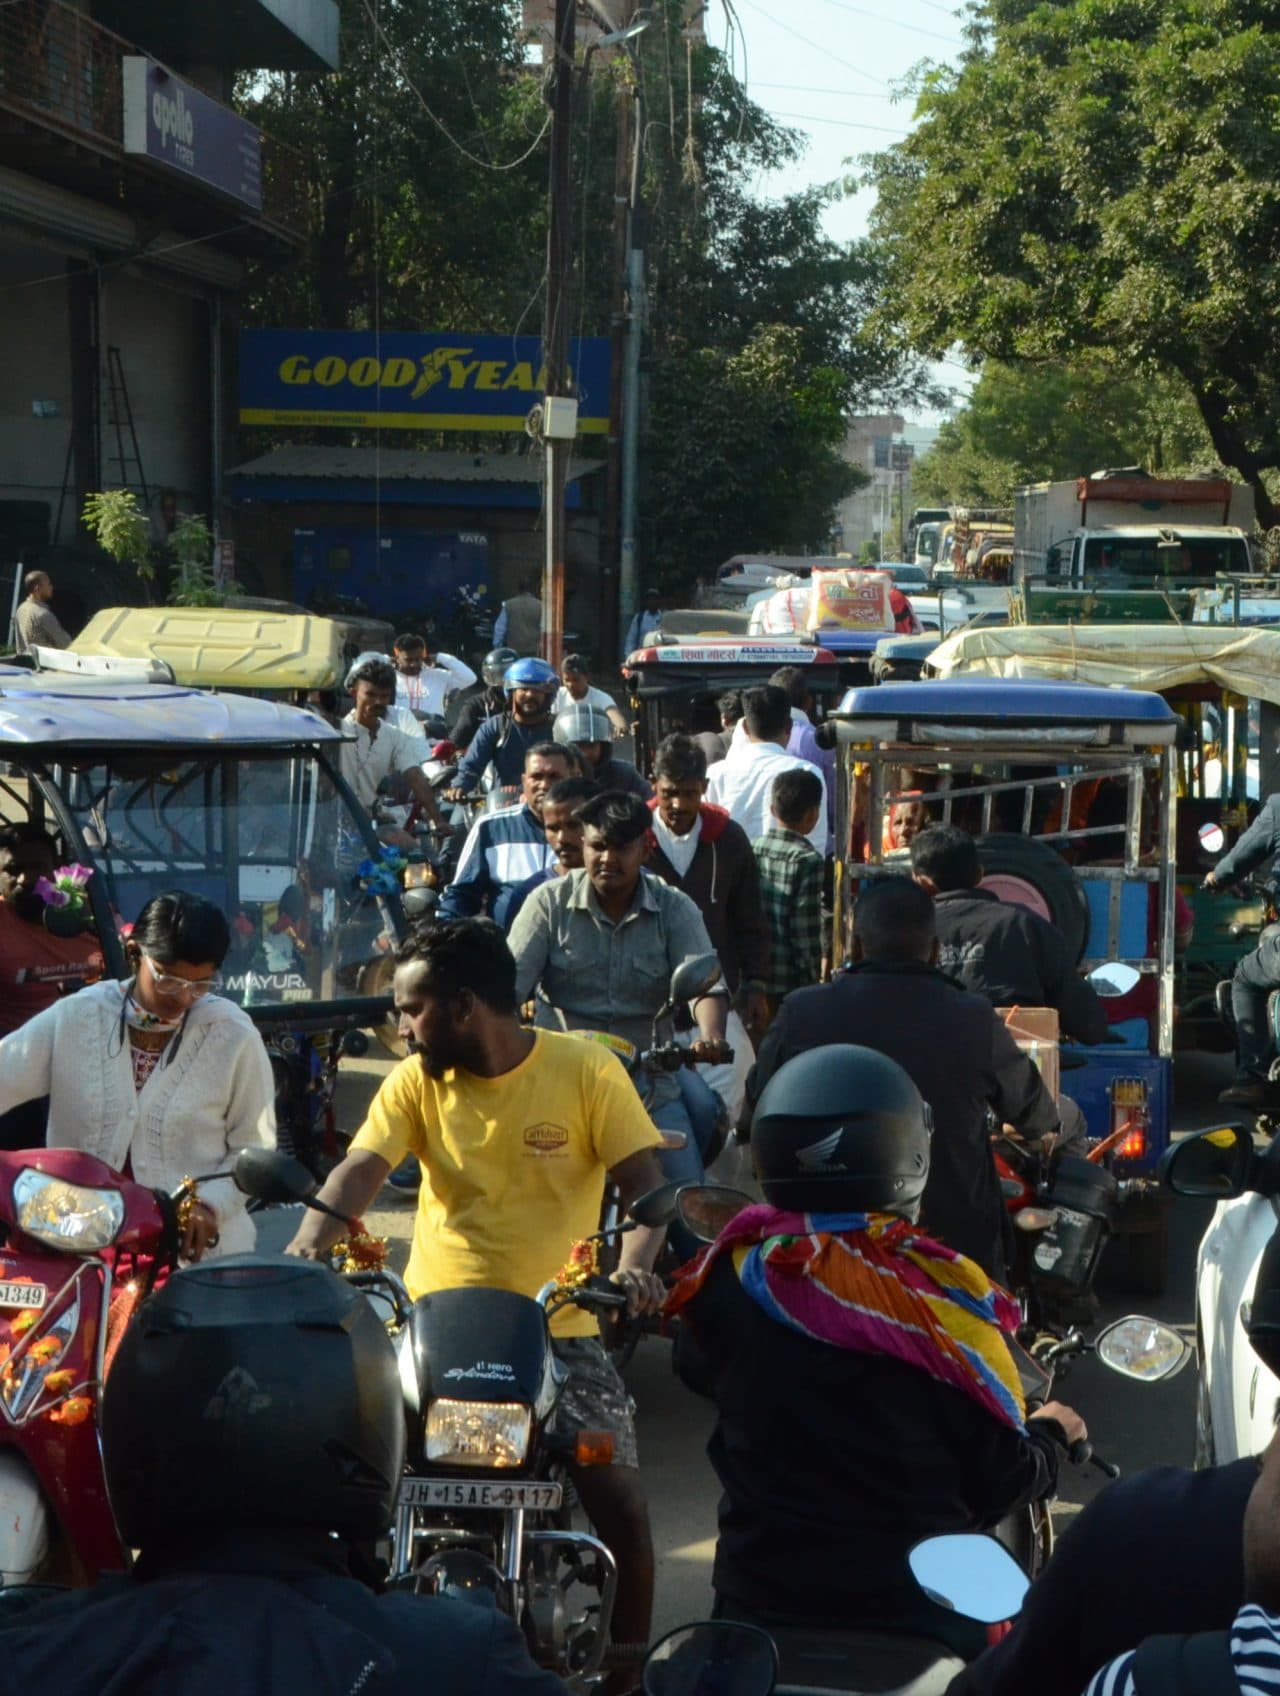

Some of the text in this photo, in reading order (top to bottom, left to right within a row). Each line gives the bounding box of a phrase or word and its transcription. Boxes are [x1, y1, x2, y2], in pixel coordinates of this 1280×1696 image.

[152, 88, 193, 148] apollo
[278, 351, 573, 395] GOODYEA
[459, 534, 488, 545] TATA
[4, 1287, 42, 1304] 1349
[405, 1483, 430, 1502] JH
[444, 1485, 492, 1504] 15AE
